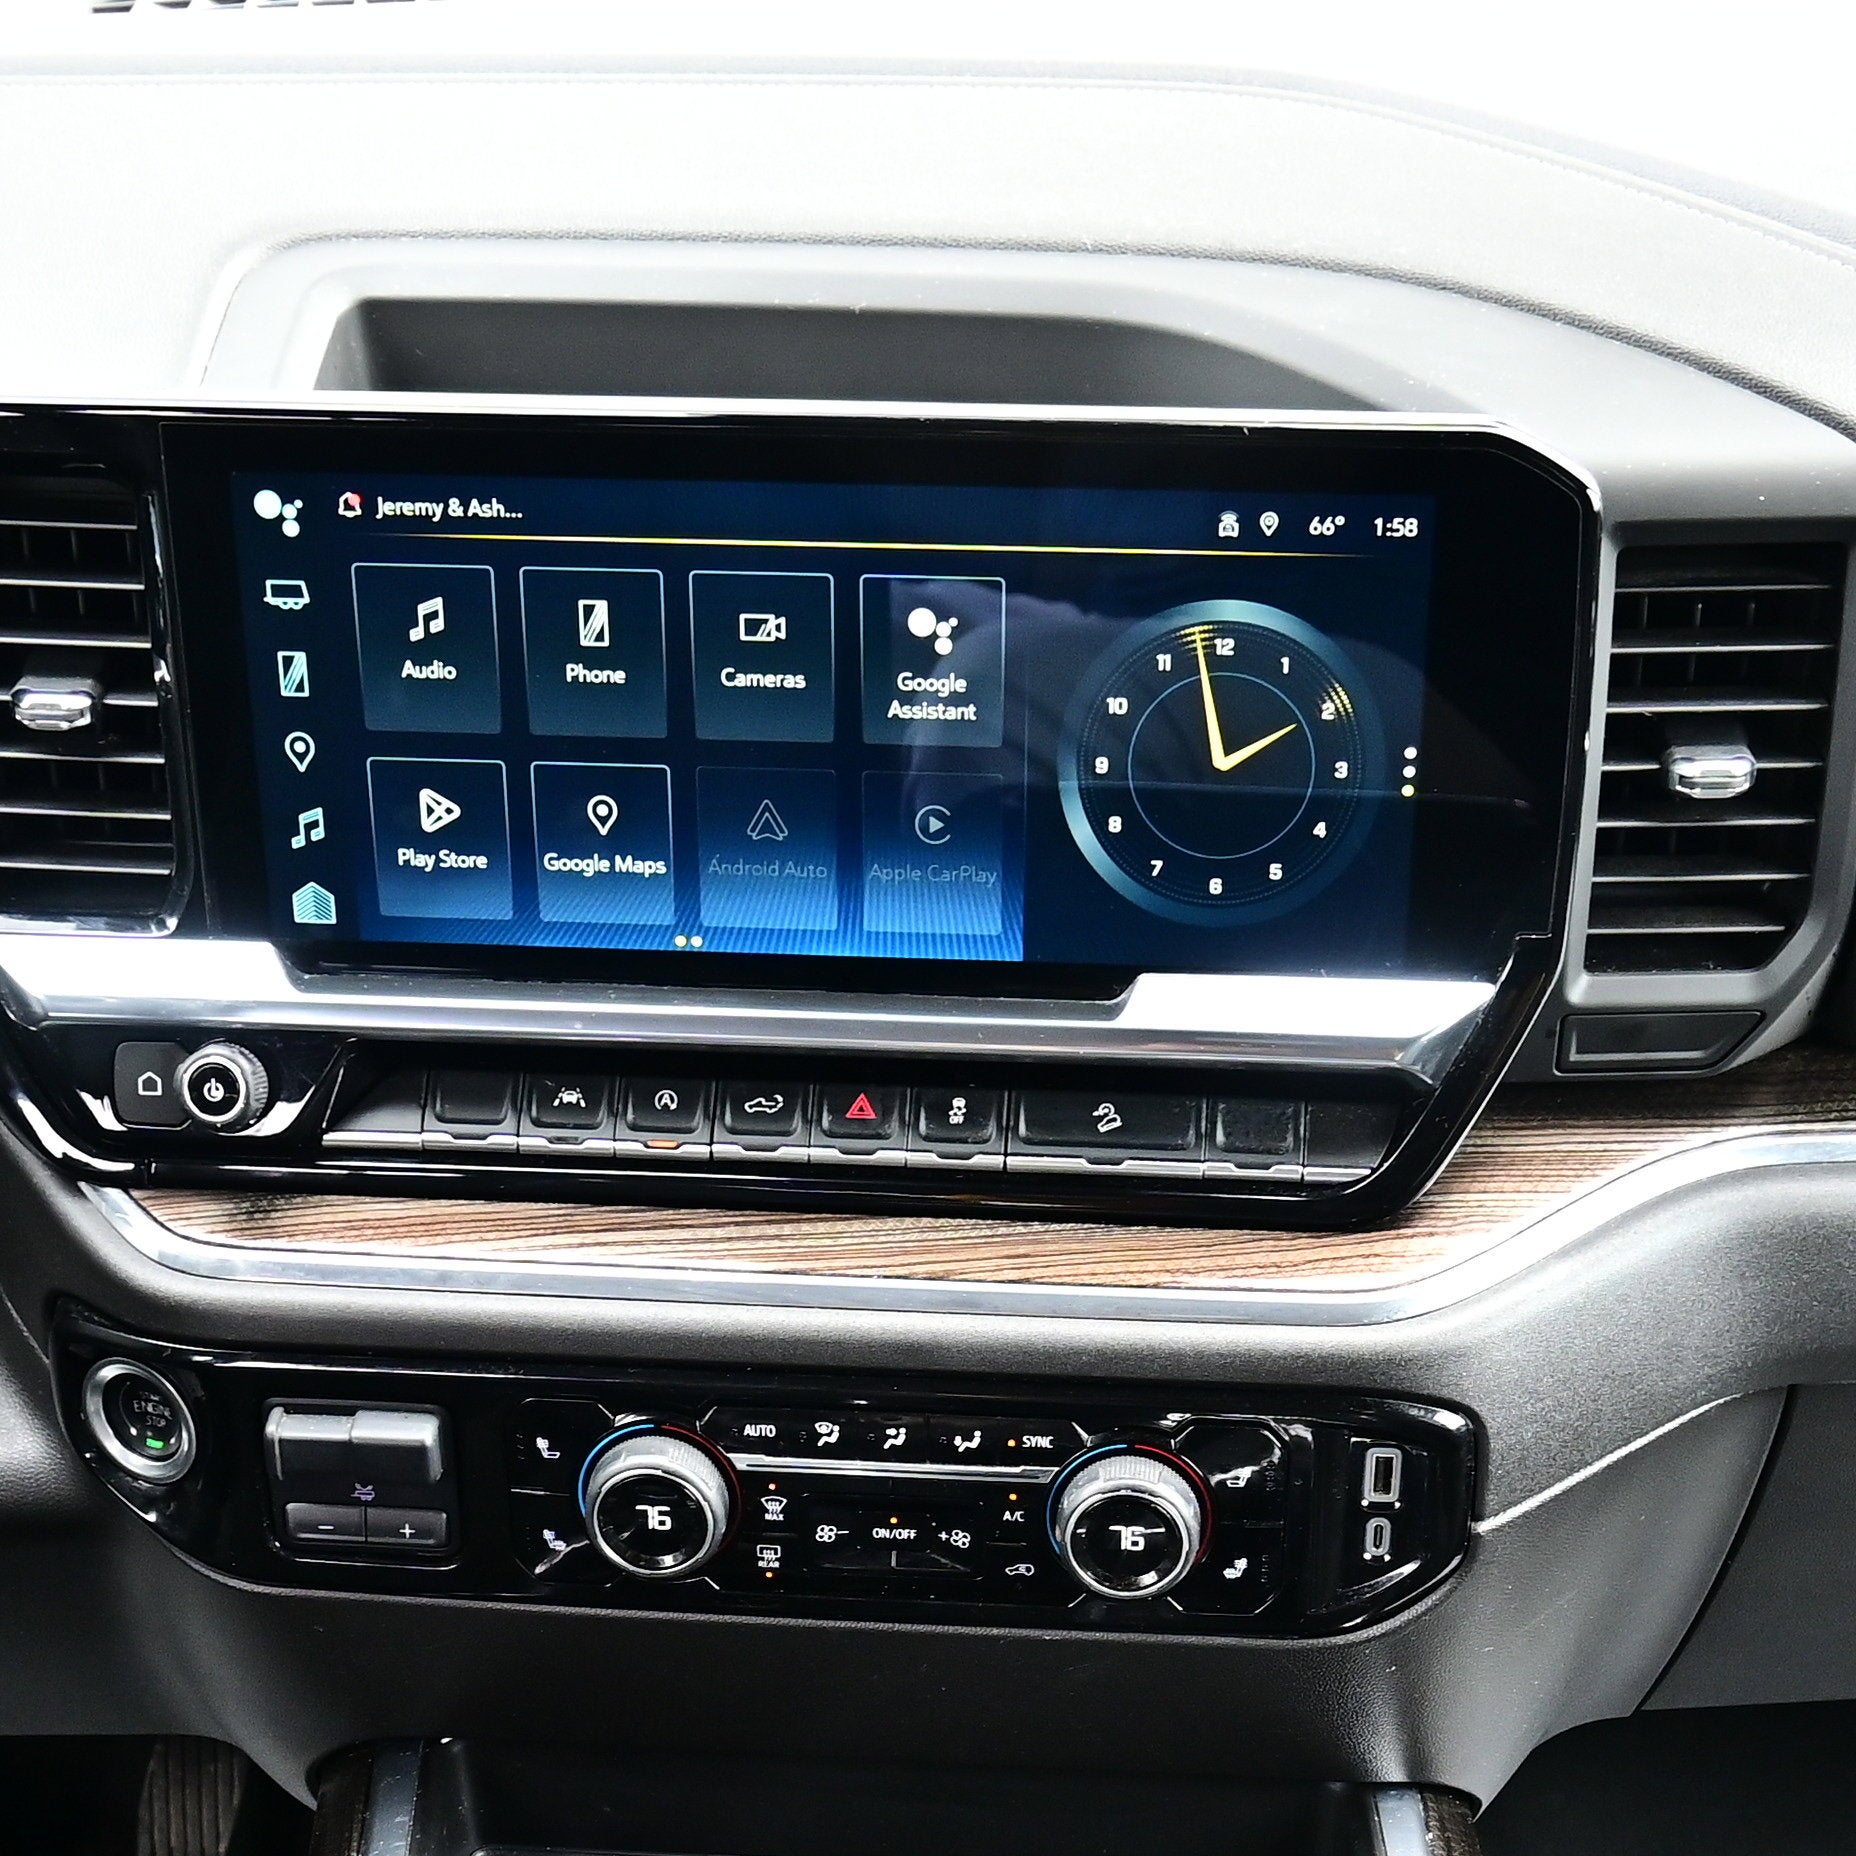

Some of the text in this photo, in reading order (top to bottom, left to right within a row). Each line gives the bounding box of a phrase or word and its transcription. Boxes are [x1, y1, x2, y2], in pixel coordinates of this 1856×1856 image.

[375, 496, 523, 522] Jeremy & Ash...
[1373, 517, 1419, 537] 1:58
[1214, 637, 1235, 656] 12
[401, 659, 457, 680] Audio
[1156, 653, 1172, 671] 11
[1280, 656, 1290, 674] 1
[565, 663, 627, 684] Phone
[720, 667, 806, 689] Cameras
[896, 671, 967, 697] Google
[887, 699, 977, 720] Assistant
[1106, 697, 1128, 715] 10
[1320, 702, 1335, 720] 2
[1095, 756, 1109, 774] 9
[1334, 761, 1348, 779] 3
[1107, 815, 1122, 833] 8
[1313, 821, 1327, 838] 4
[397, 848, 488, 872] Play Store
[543, 852, 667, 877] Google Maps
[708, 857, 828, 878] Android Auto
[1150, 860, 1163, 877] 7
[869, 863, 997, 887] Apple CarPlay
[1268, 863, 1283, 880] 5
[1209, 877, 1223, 895] 6
[743, 1424, 776, 1438] AUTO
[1022, 1435, 1054, 1449] SYNC
[635, 1505, 672, 1530] 76
[764, 1513, 784, 1521] MAX
[1003, 1510, 1025, 1522] A/C
[872, 1527, 917, 1541] ON/OFF
[1108, 1525, 1146, 1551] 76
